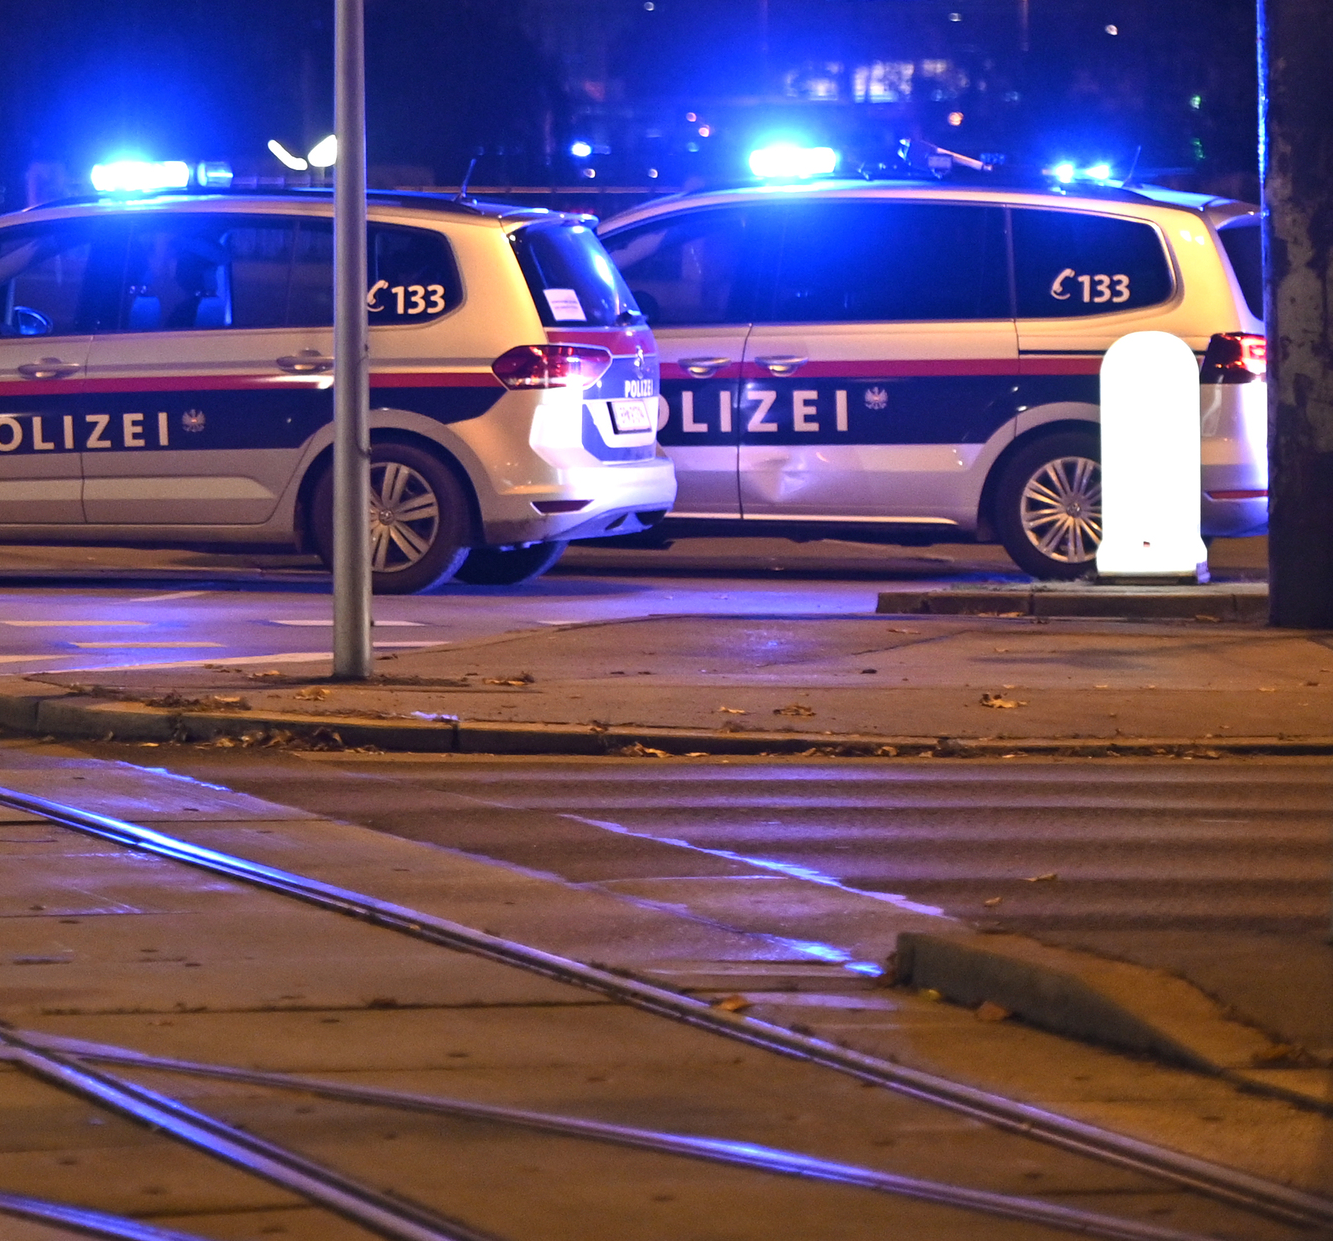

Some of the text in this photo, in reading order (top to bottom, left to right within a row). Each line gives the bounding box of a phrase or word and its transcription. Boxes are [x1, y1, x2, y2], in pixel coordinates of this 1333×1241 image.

[391, 284, 446, 315] 133
[1077, 273, 1131, 303] 133
[624, 379, 654, 398] POLIZEI
[658, 390, 848, 433] LIZEI
